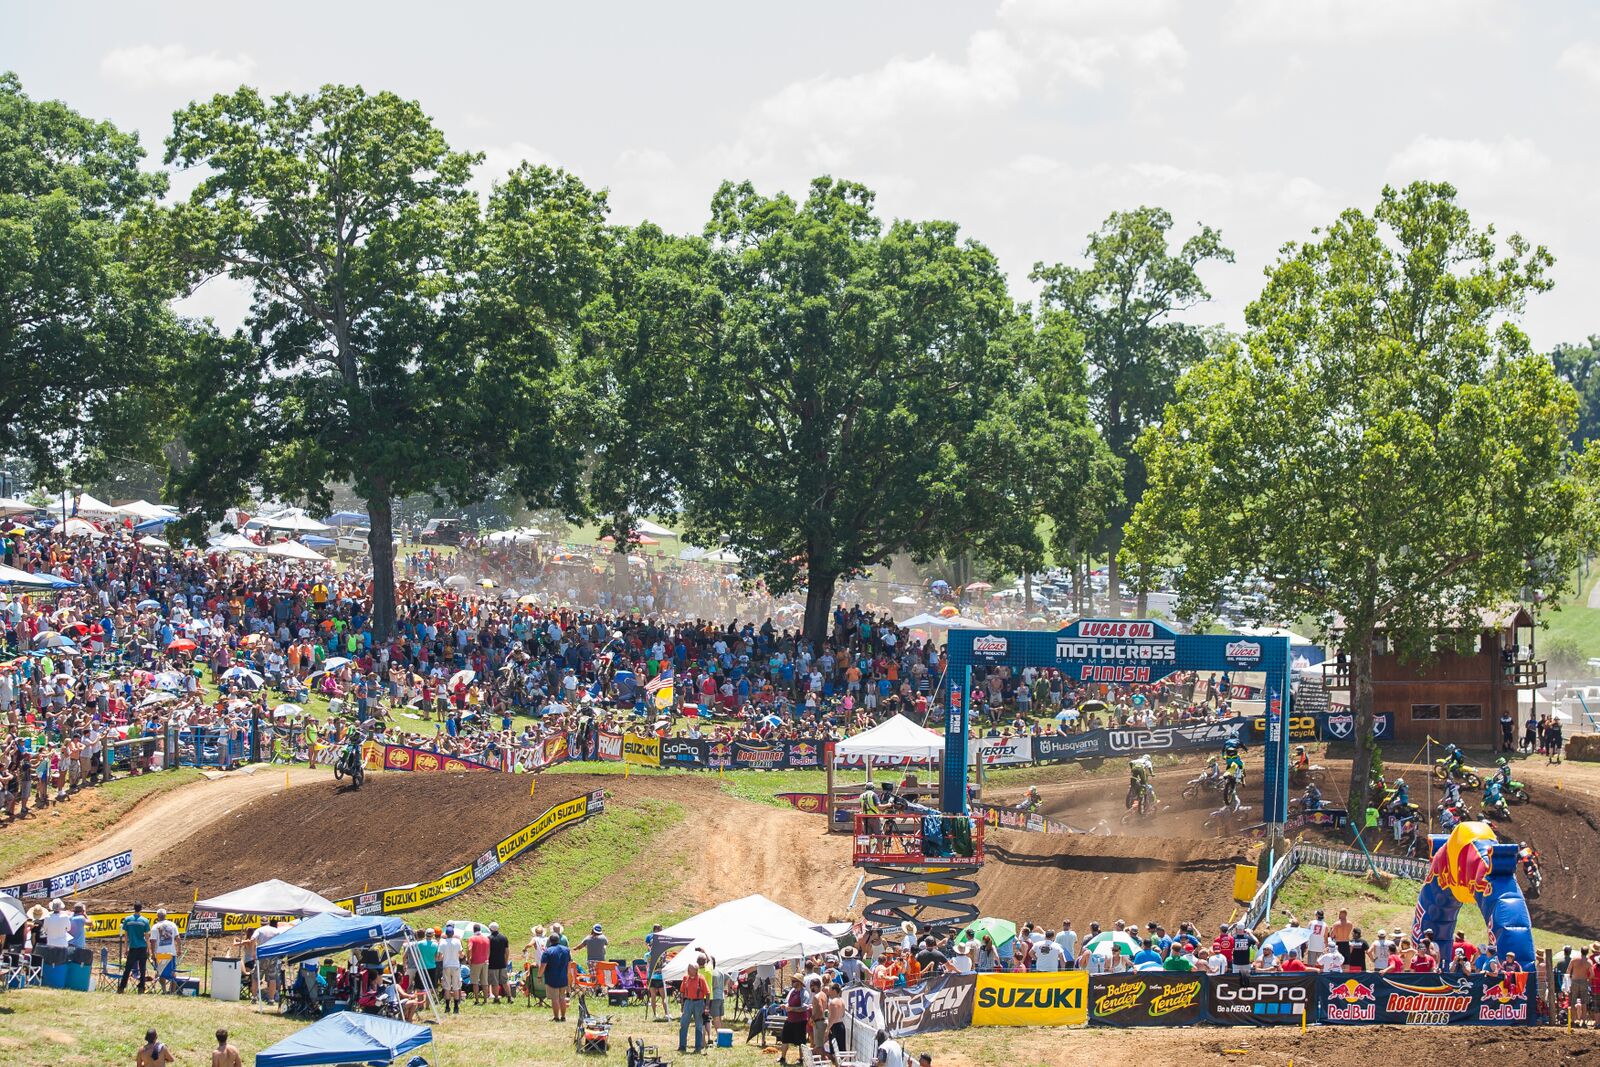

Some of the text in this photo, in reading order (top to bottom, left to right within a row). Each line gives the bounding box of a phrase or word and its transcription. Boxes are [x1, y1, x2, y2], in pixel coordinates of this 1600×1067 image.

[1082, 622, 1151, 637] LUCAS OIL
[977, 643, 1006, 651] LUCAS
[1056, 643, 1176, 659] MOTOCROSS
[1229, 648, 1259, 656] LUCAS
[1081, 665, 1151, 681] FINISH
[1231, 686, 1247, 699] OIL
[1254, 717, 1315, 730] GCO
[1335, 723, 1347, 734] X
[1051, 738, 1099, 751] Husqvarna
[1109, 729, 1174, 751] WPS
[624, 742, 658, 757] SUZUKI
[663, 743, 699, 755] GoPro
[736, 750, 785, 762] Roadrunner
[979, 745, 1018, 756] VERTEX
[557, 801, 585, 820] SUZUKI
[531, 812, 556, 838] SUZUKI
[499, 834, 528, 858] SUZUKI
[97, 860, 113, 876] EBC
[114, 854, 132, 869] EBC
[65, 872, 80, 888] EBC
[80, 867, 96, 881] EBC
[444, 871, 472, 891] SUZUKI
[386, 892, 417, 907] SUZUKI
[420, 885, 445, 900] SUZUKI
[226, 913, 257, 926] SUZUKI
[1235, 941, 1248, 949] FIRE
[1107, 980, 1144, 997] Battery
[1163, 980, 1199, 997] Battery
[1216, 983, 1306, 1001] GoPro
[929, 983, 973, 1013] FLY
[978, 987, 1083, 1008] SUZUKI
[1095, 993, 1137, 1013] Tender
[1150, 993, 1193, 1013] Tender
[1386, 993, 1472, 1012] Roadrunner
[1217, 1005, 1225, 1013] Be
[1230, 1005, 1252, 1013] HERO.
[1328, 1004, 1376, 1020] Red Bull
[1479, 1004, 1528, 1020] Red Bull
[1406, 1011, 1450, 1025] Markets
